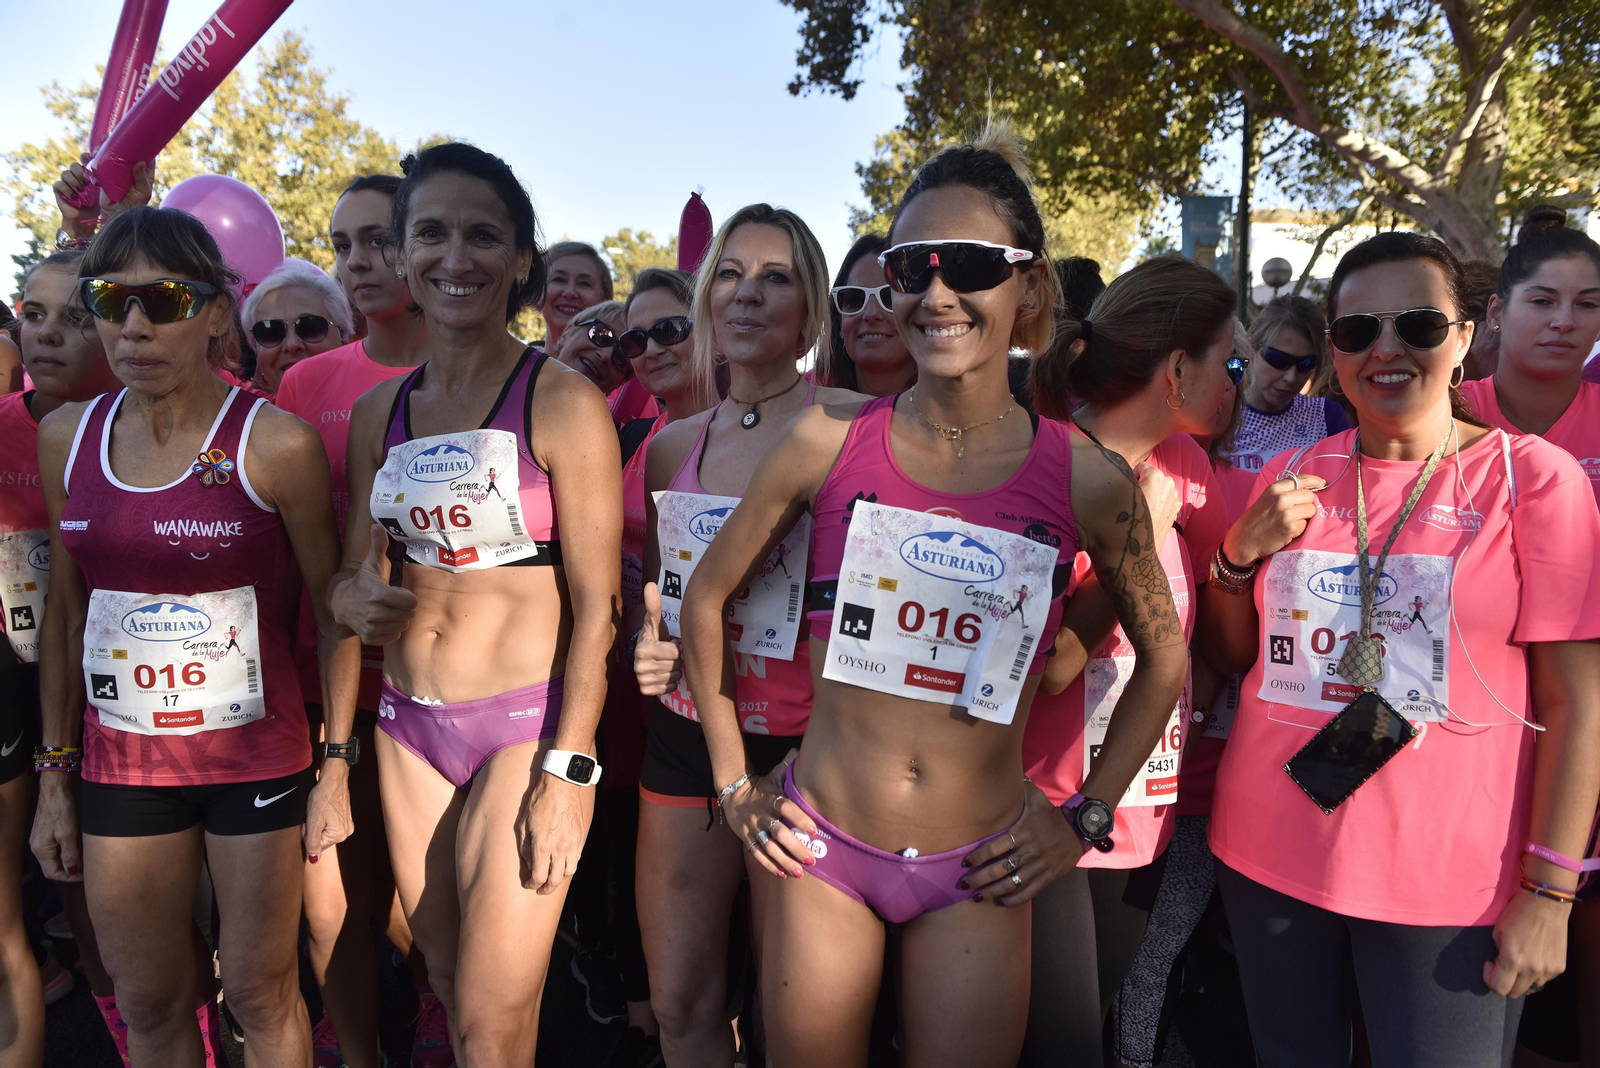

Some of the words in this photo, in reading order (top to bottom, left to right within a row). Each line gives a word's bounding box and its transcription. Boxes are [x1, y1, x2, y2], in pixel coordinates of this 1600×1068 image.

[157, 12, 236, 102] Ladival
[409, 460, 469, 475] ASTURIANA
[449, 481, 479, 491] Carrera
[467, 490, 490, 504] Mujer
[409, 504, 472, 531] 016
[994, 512, 1017, 522] Club
[1020, 516, 1062, 530] Atletismo
[1423, 510, 1482, 529] ASTURIANA
[153, 519, 244, 538] WANAWAKE
[1029, 530, 1057, 545] betta
[494, 545, 523, 557] ZURICH
[925, 543, 958, 554] CENTRAL
[961, 550, 995, 563] LECHERA
[905, 542, 996, 577] ASTURIANA
[861, 573, 873, 581] IMD
[963, 585, 1005, 604] Carrera
[971, 599, 980, 608] de
[984, 603, 1013, 622] Mujer
[1371, 608, 1401, 619] Carrera
[128, 617, 205, 633] ASTURIANA
[897, 601, 983, 644] 016
[1386, 617, 1413, 636] Mujer
[182, 640, 218, 650] Carrera
[755, 640, 782, 650] ZURICH
[204, 648, 229, 662] Mujer
[930, 646, 938, 661] 1
[838, 654, 886, 675] OYSHO
[133, 662, 206, 689] 016
[922, 674, 957, 687] Santander
[1271, 680, 1305, 693] OYSHO
[162, 694, 179, 707] 17
[740, 702, 768, 711] 2017
[166, 715, 197, 724] Santander
[221, 712, 252, 722] ZURICH
[1161, 725, 1181, 752] 16
[1148, 759, 1174, 773] 5431
[1534, 848, 1556, 860] ZURICH
